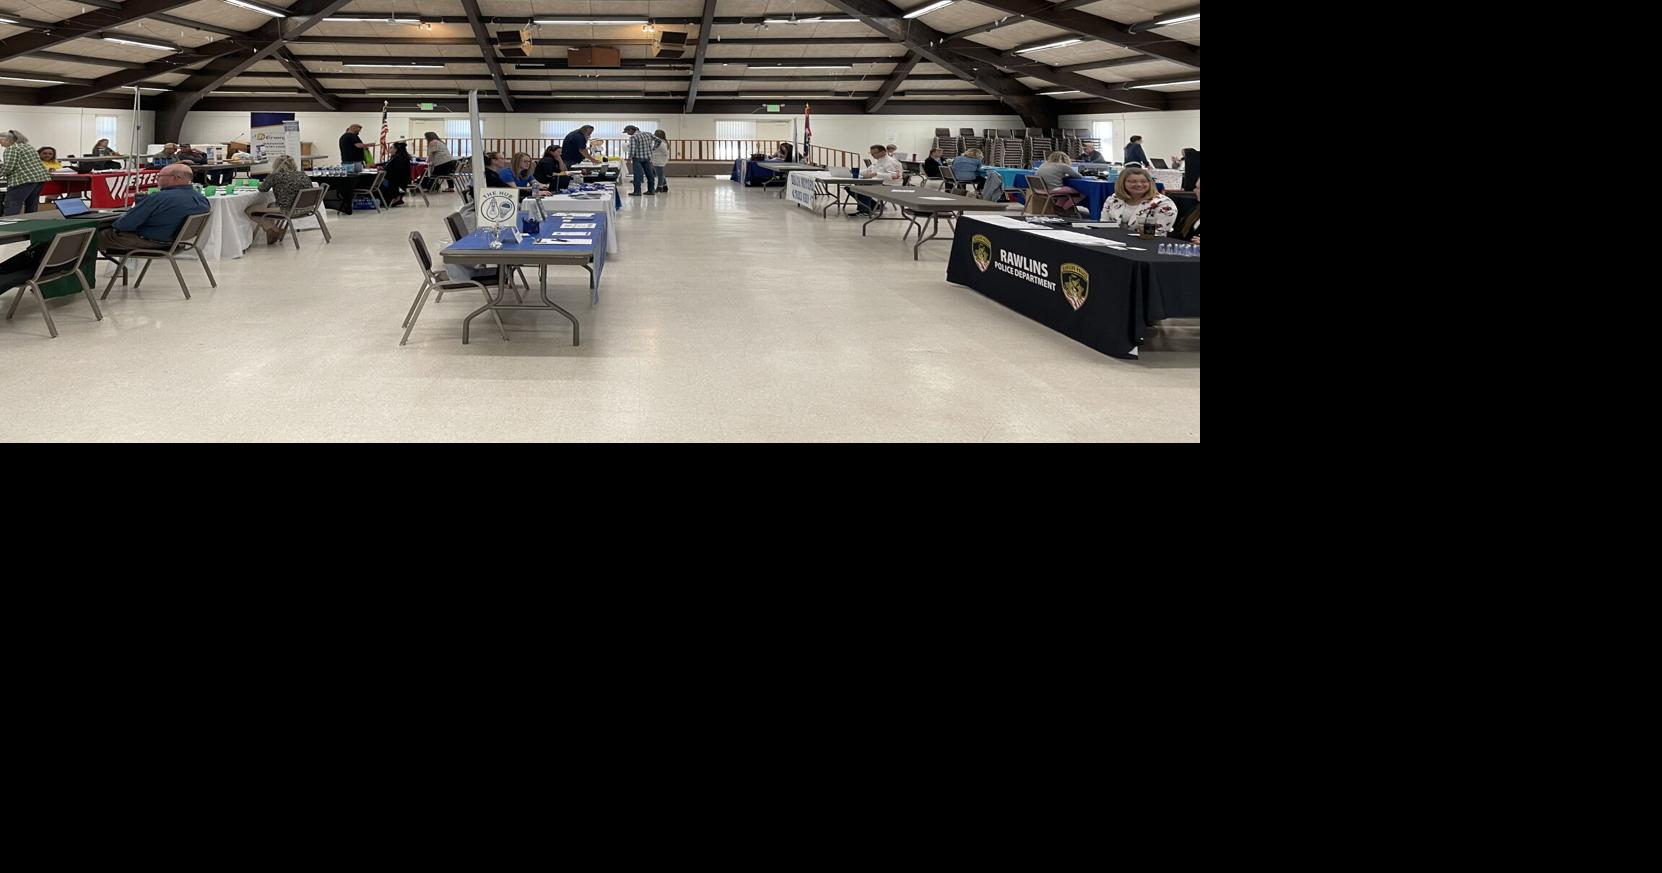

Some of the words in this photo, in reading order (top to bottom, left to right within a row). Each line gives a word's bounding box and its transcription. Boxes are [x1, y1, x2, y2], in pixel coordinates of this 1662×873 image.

[105, 173, 160, 200] WESTE
[994, 261, 1015, 276] POLICE
[1014, 268, 1057, 292] DEPARTMENT
[1000, 249, 1049, 278] RAWLINS
